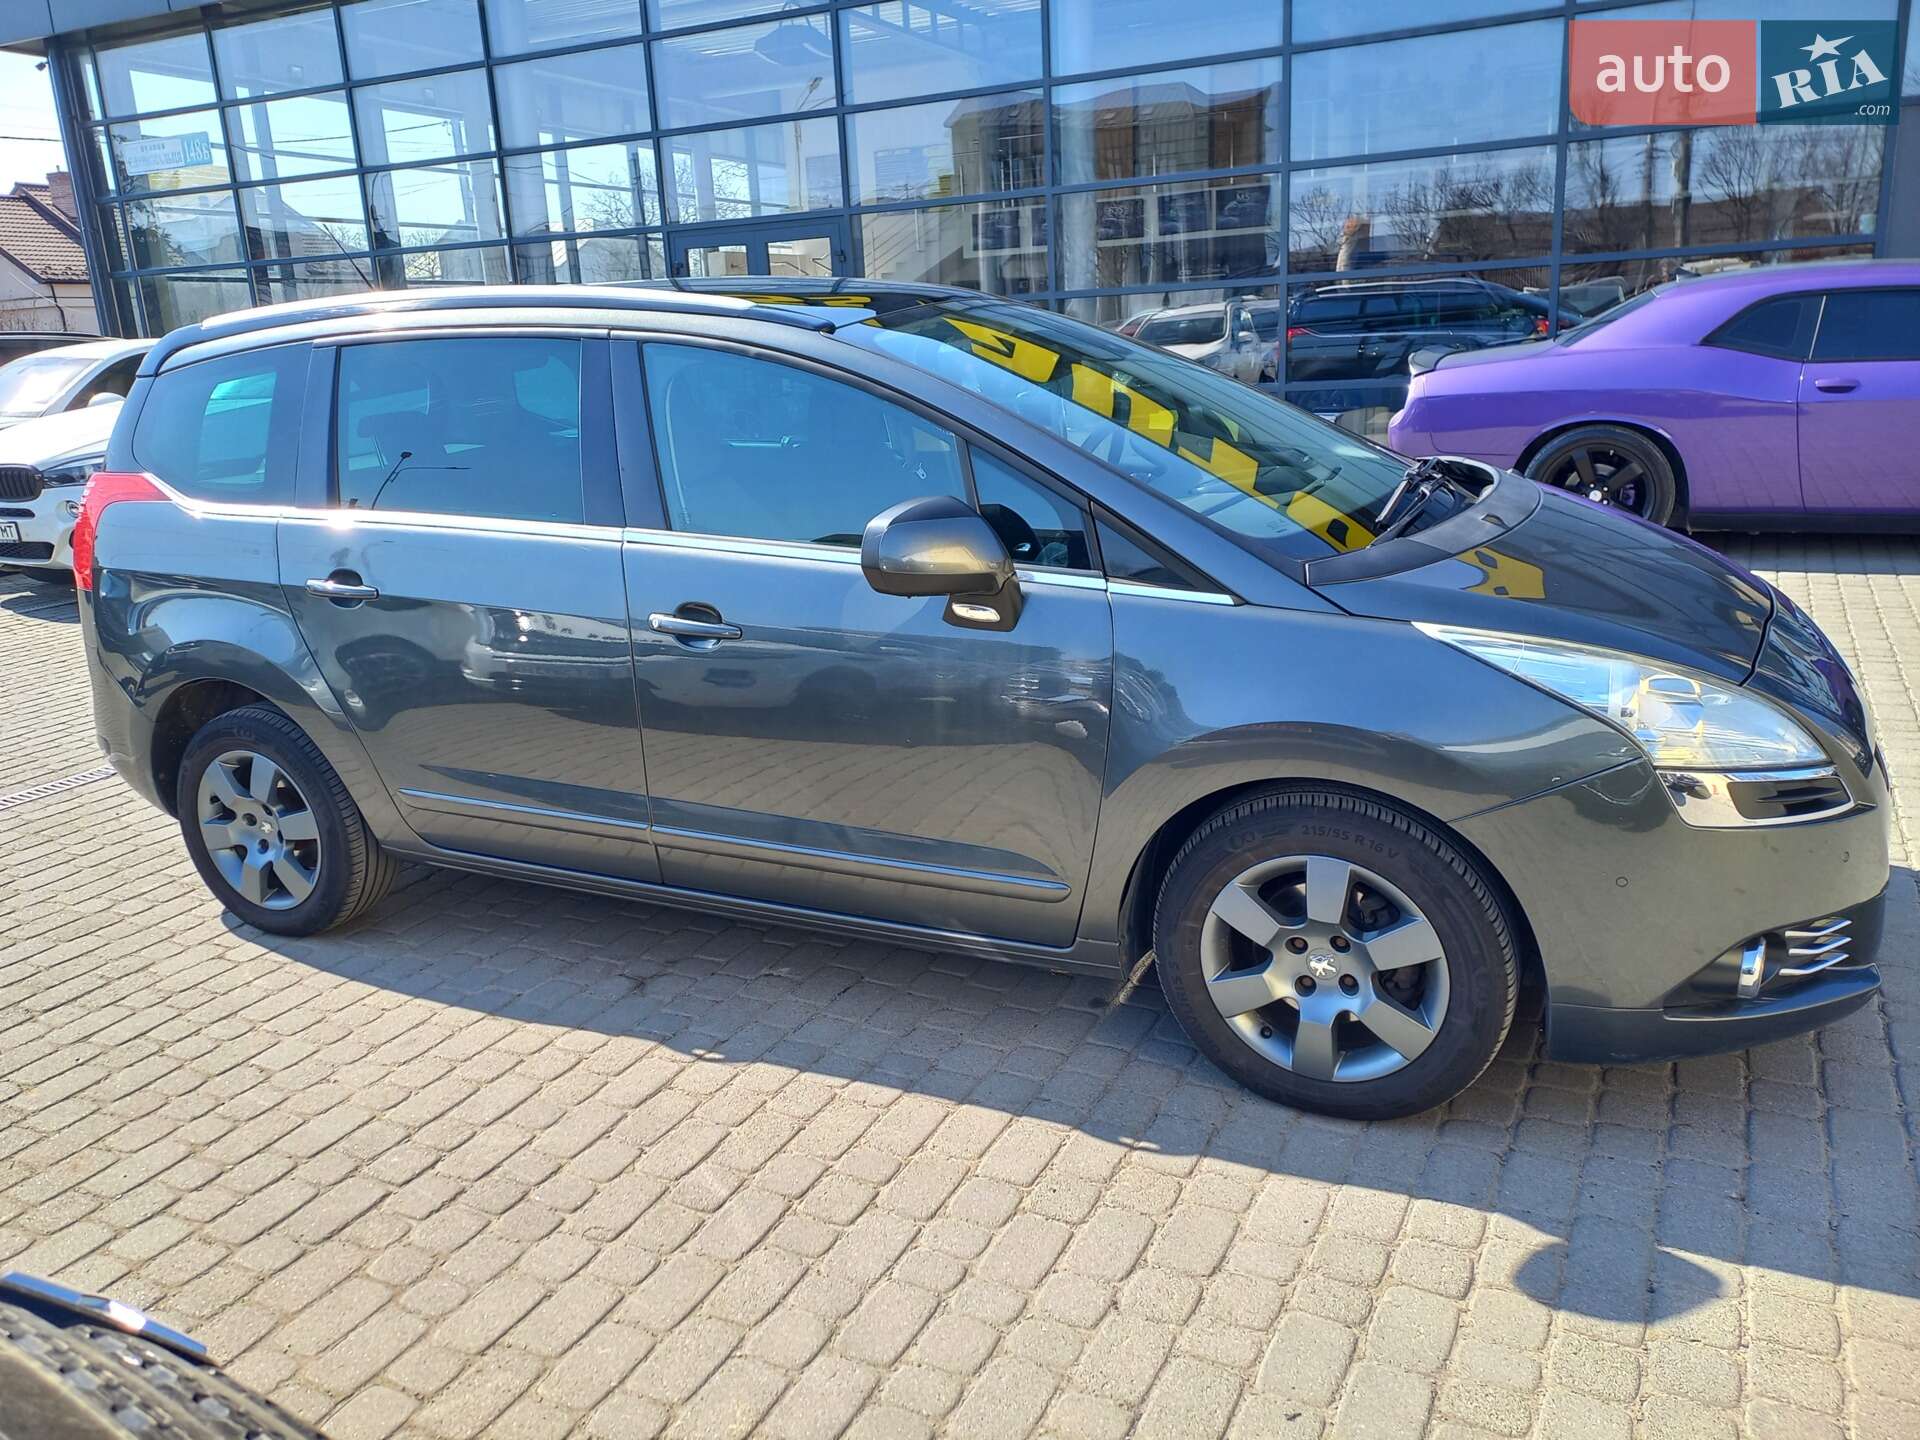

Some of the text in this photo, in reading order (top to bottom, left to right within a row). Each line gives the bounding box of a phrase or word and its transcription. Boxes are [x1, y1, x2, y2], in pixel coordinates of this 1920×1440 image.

[1301, 824, 1351, 841] 215/55
[1354, 834, 1366, 846] R
[1368, 839, 1385, 853] 16
